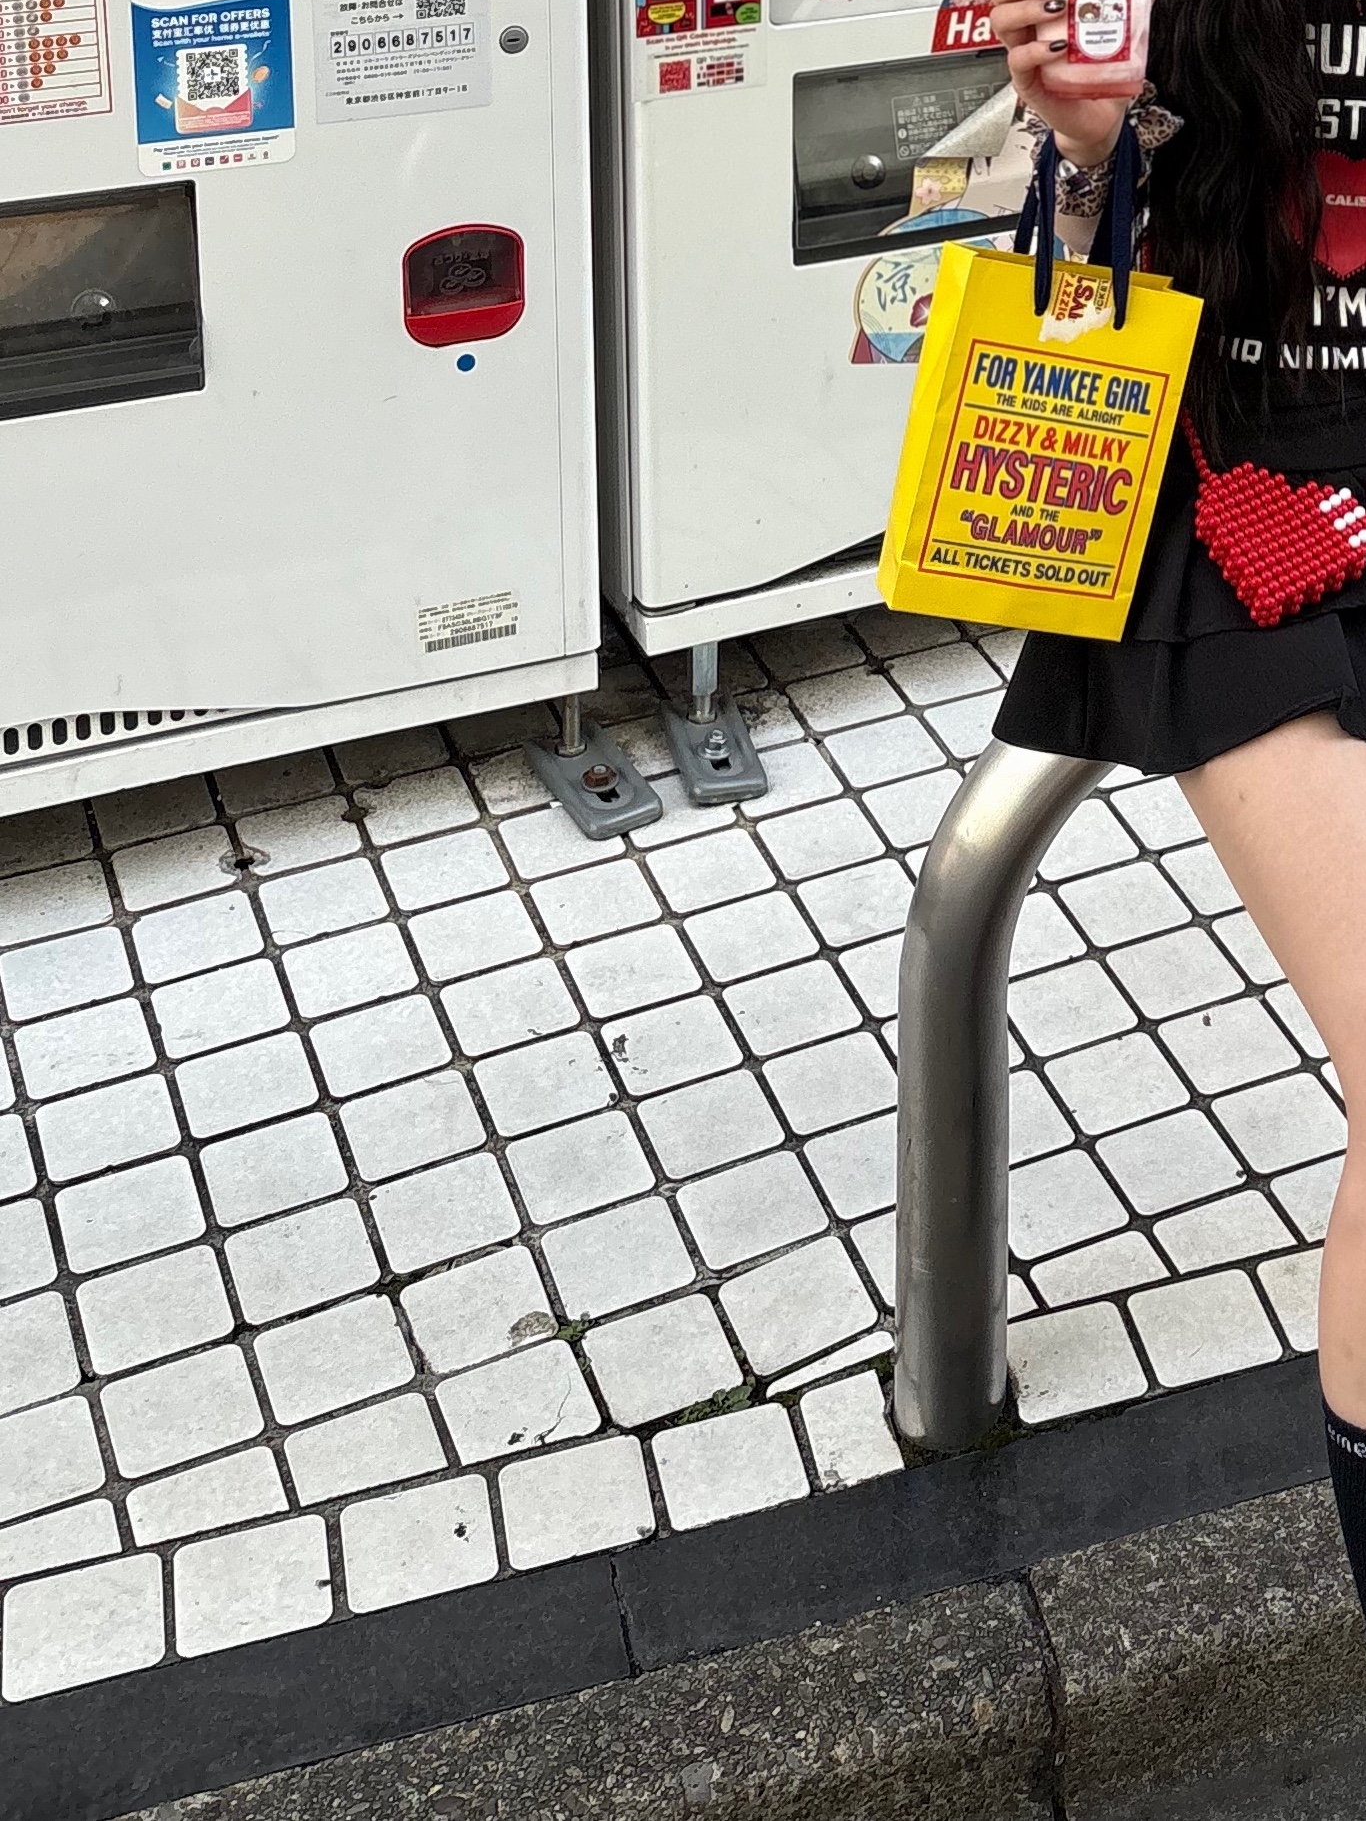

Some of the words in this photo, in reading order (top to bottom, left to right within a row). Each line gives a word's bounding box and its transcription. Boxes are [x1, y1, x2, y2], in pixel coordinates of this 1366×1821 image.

[151, 14, 189, 29] SCAN
[191, 11, 218, 25] FOR
[220, 7, 271, 22] OFFERS
[350, 13, 390, 26] こちらから
[875, 261, 917, 312] 涼
[1055, 279, 1074, 321] DIZZY
[972, 352, 1016, 391] FOR
[1022, 359, 1101, 407] YANKEE
[1104, 376, 1152, 416] GIRL
[996, 393, 1017, 407] THE
[1020, 396, 1047, 414] KIDS
[1050, 402, 1074, 418] ARE
[1076, 406, 1124, 426] ALRIGHT
[973, 415, 1038, 443] DIZZY
[1040, 426, 1058, 451] &
[1062, 432, 1131, 464] MILKY
[949, 441, 1133, 517] HYSTERIC
[1010, 504, 1035, 518] AND
[1039, 509, 1061, 523] THE
[930, 546, 961, 567] ALL
[964, 551, 1032, 578] TICKETS
[1033, 561, 1075, 583] SOLD
[1077, 568, 1111, 588] OUT
